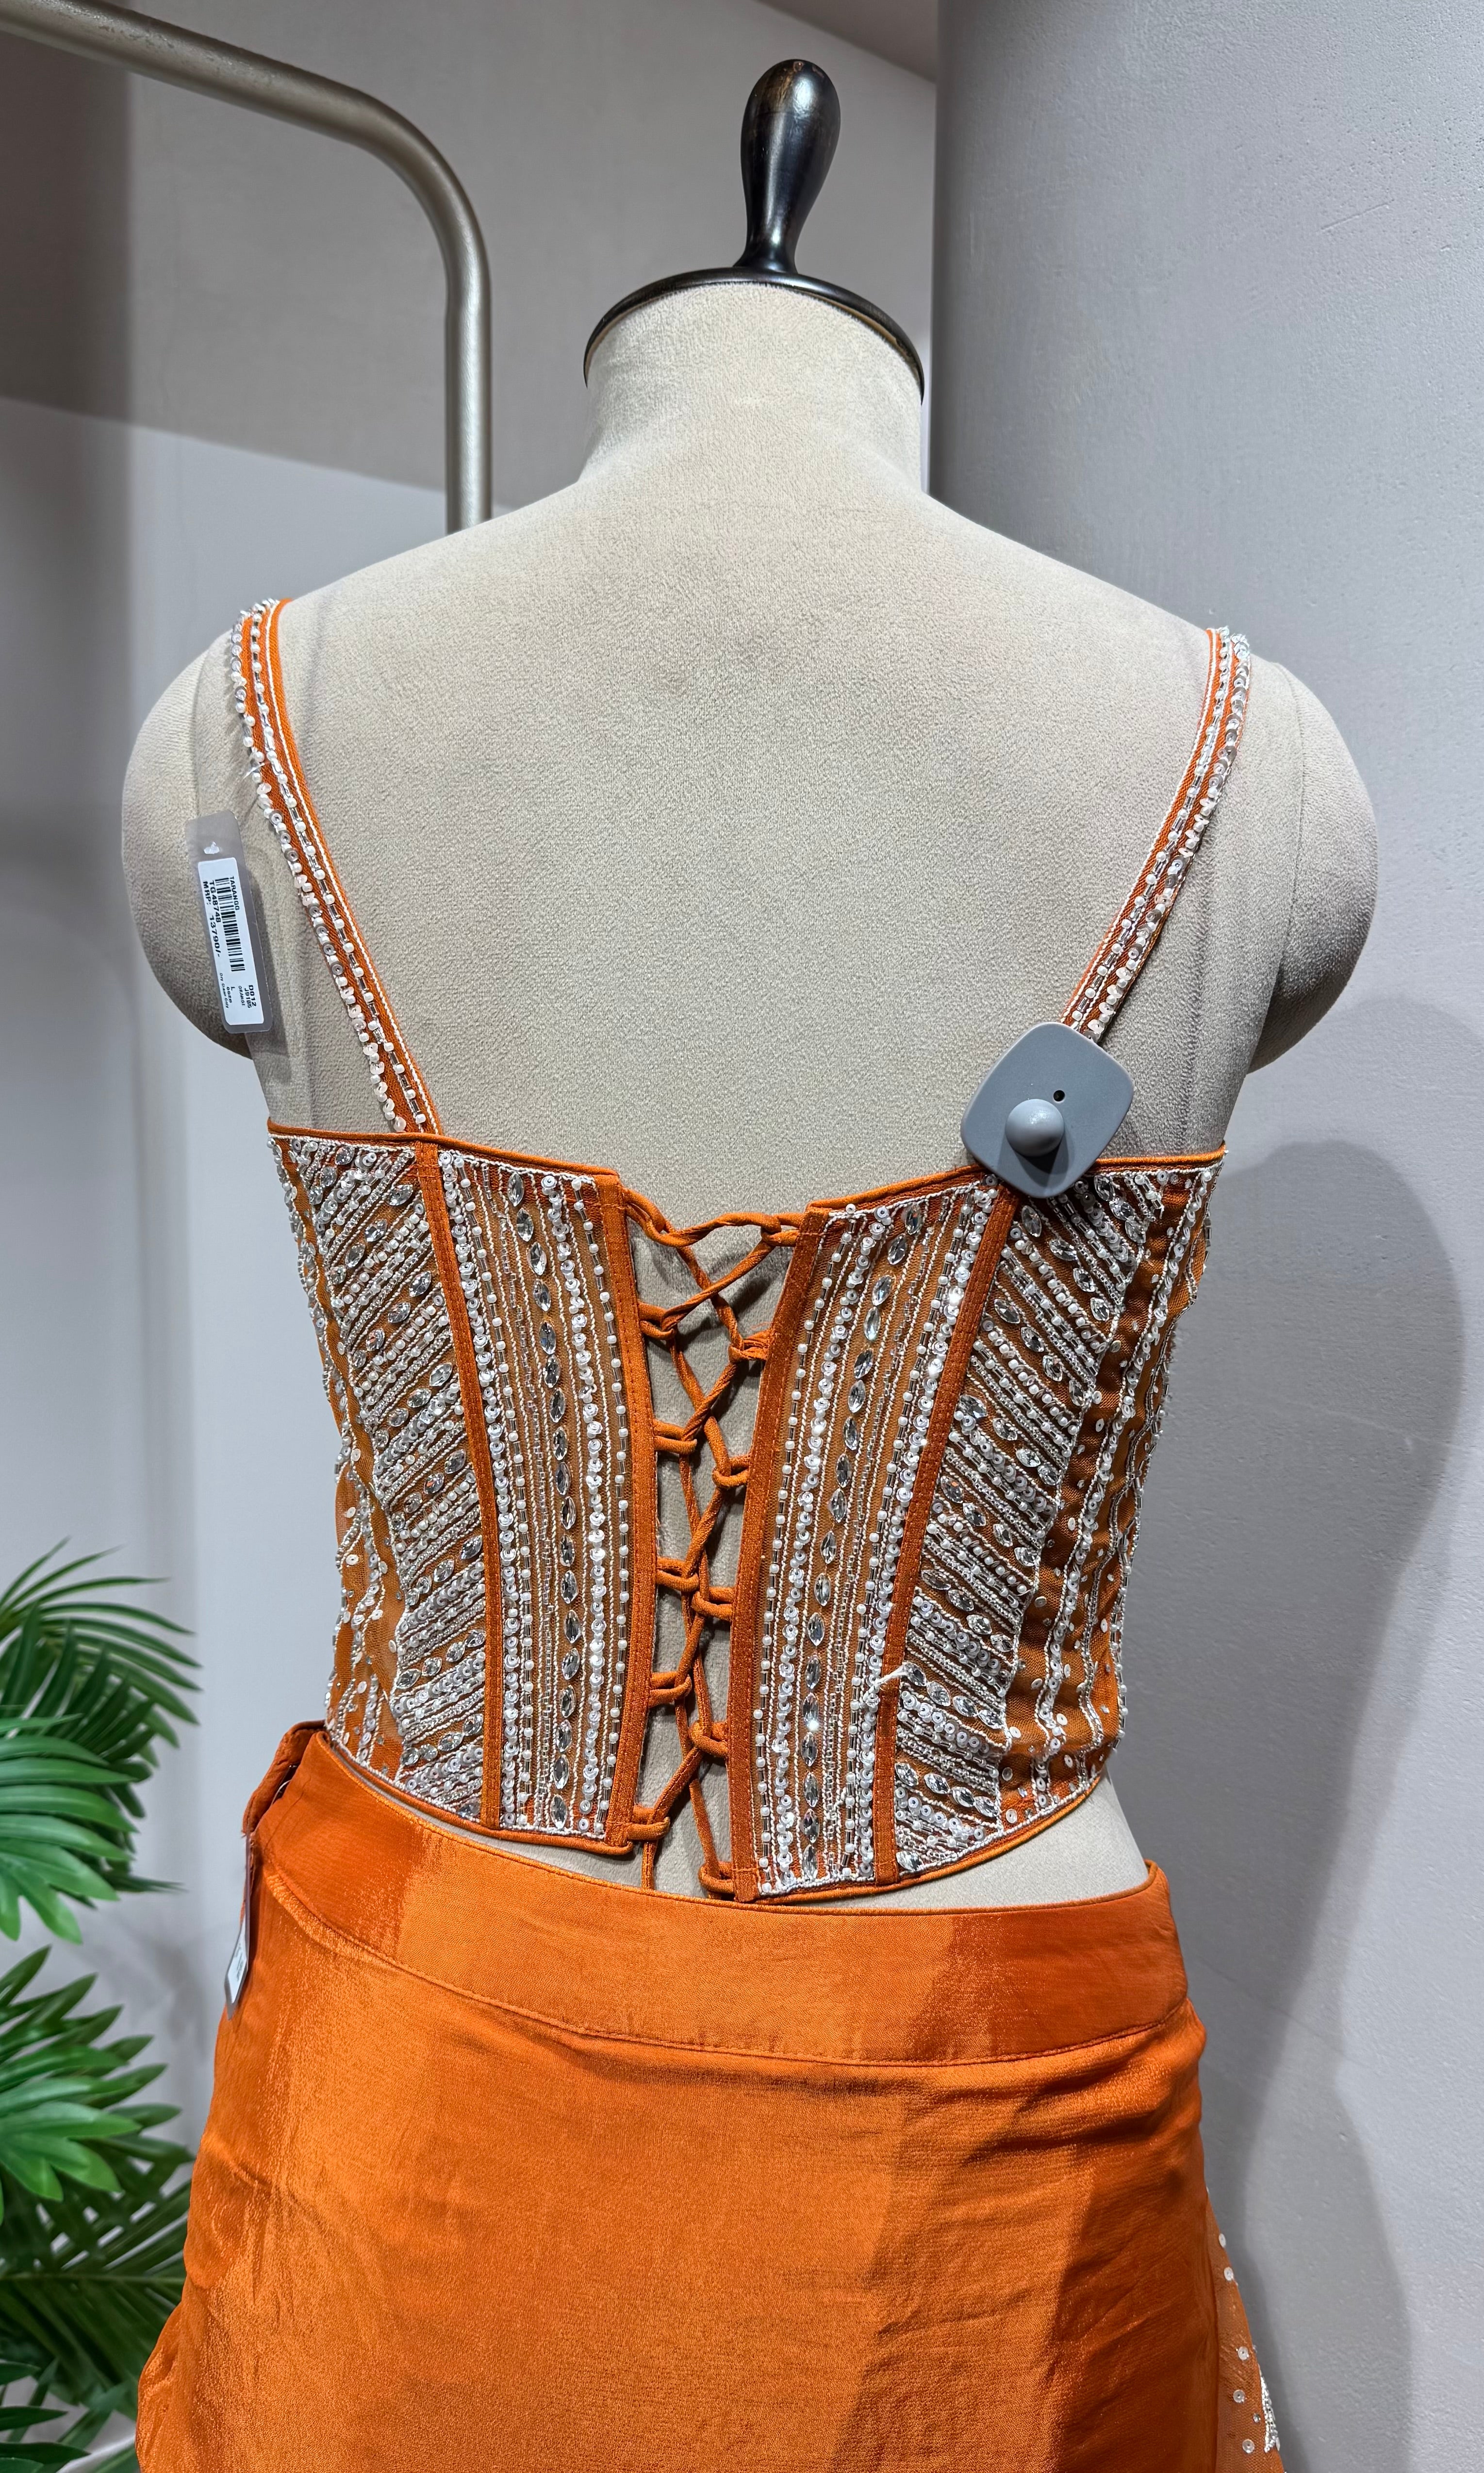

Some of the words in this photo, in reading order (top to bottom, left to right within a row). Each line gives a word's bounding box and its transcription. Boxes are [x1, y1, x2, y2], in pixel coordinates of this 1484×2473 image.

[203, 881, 211, 905] MRP:
[209, 915, 221, 957] 13790/-
[209, 880, 221, 923] TG48748
